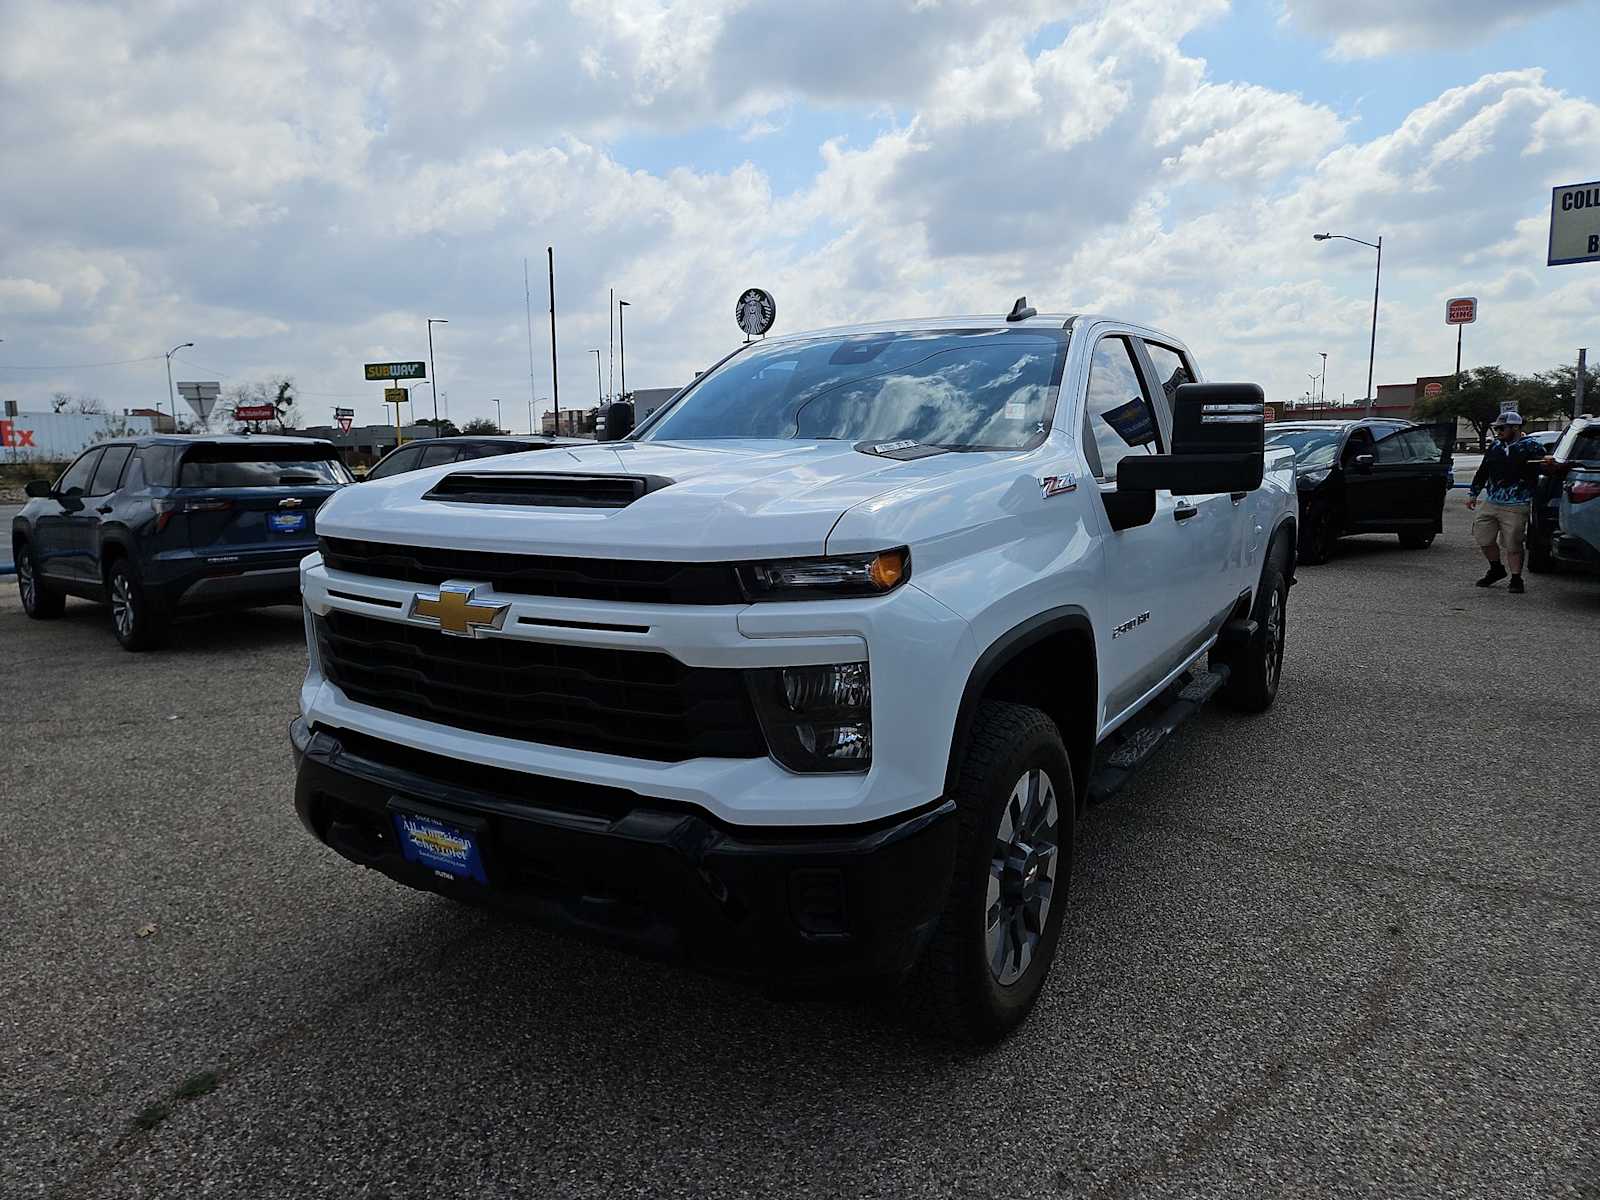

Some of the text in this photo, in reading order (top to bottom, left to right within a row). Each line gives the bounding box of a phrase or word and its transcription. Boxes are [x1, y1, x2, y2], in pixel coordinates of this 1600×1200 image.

[1562, 188, 1600, 212] COLL
[1449, 311, 1473, 319] KING
[368, 364, 416, 377] SUBWAY
[0, 419, 38, 448] Ex
